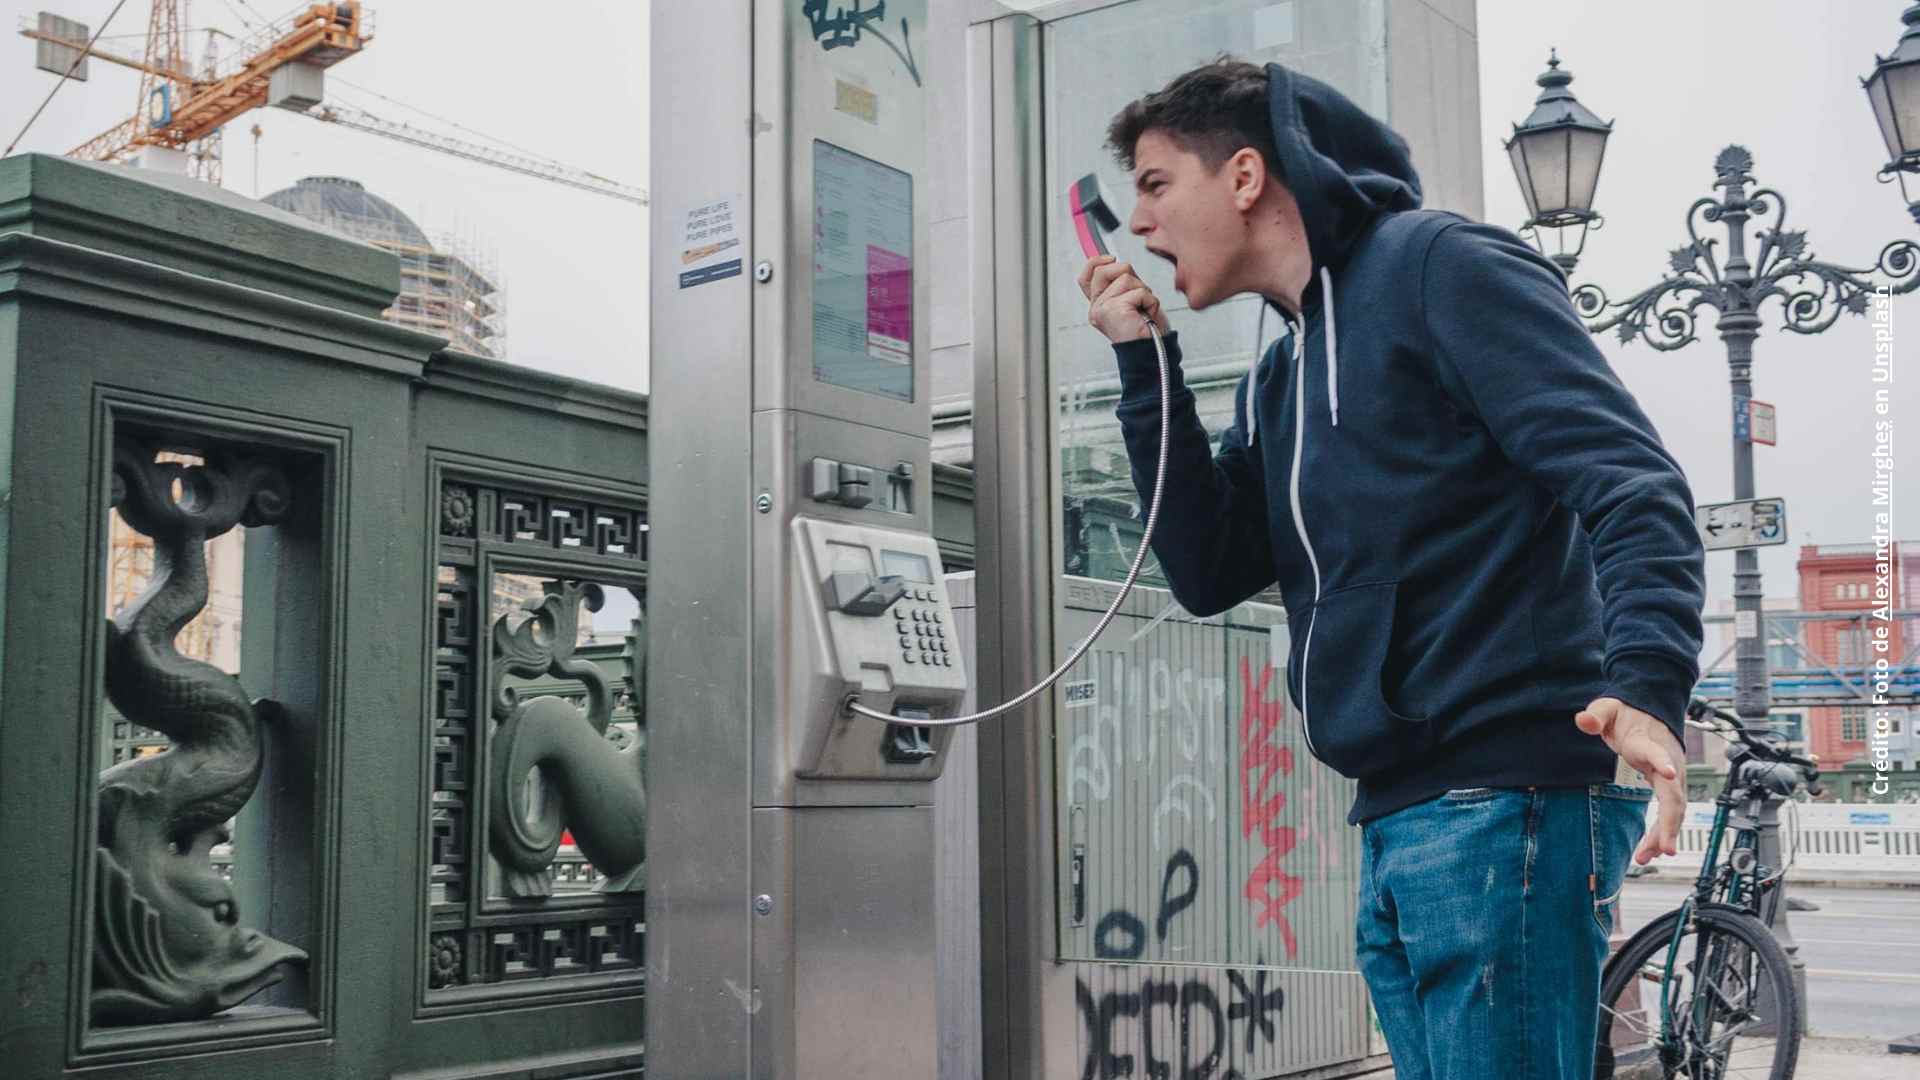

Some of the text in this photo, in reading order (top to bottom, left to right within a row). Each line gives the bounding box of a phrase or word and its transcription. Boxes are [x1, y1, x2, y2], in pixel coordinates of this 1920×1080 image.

[687, 201, 729, 218] PURE LIFE
[686, 217, 708, 231] PURE
[685, 230, 708, 242] PURE
